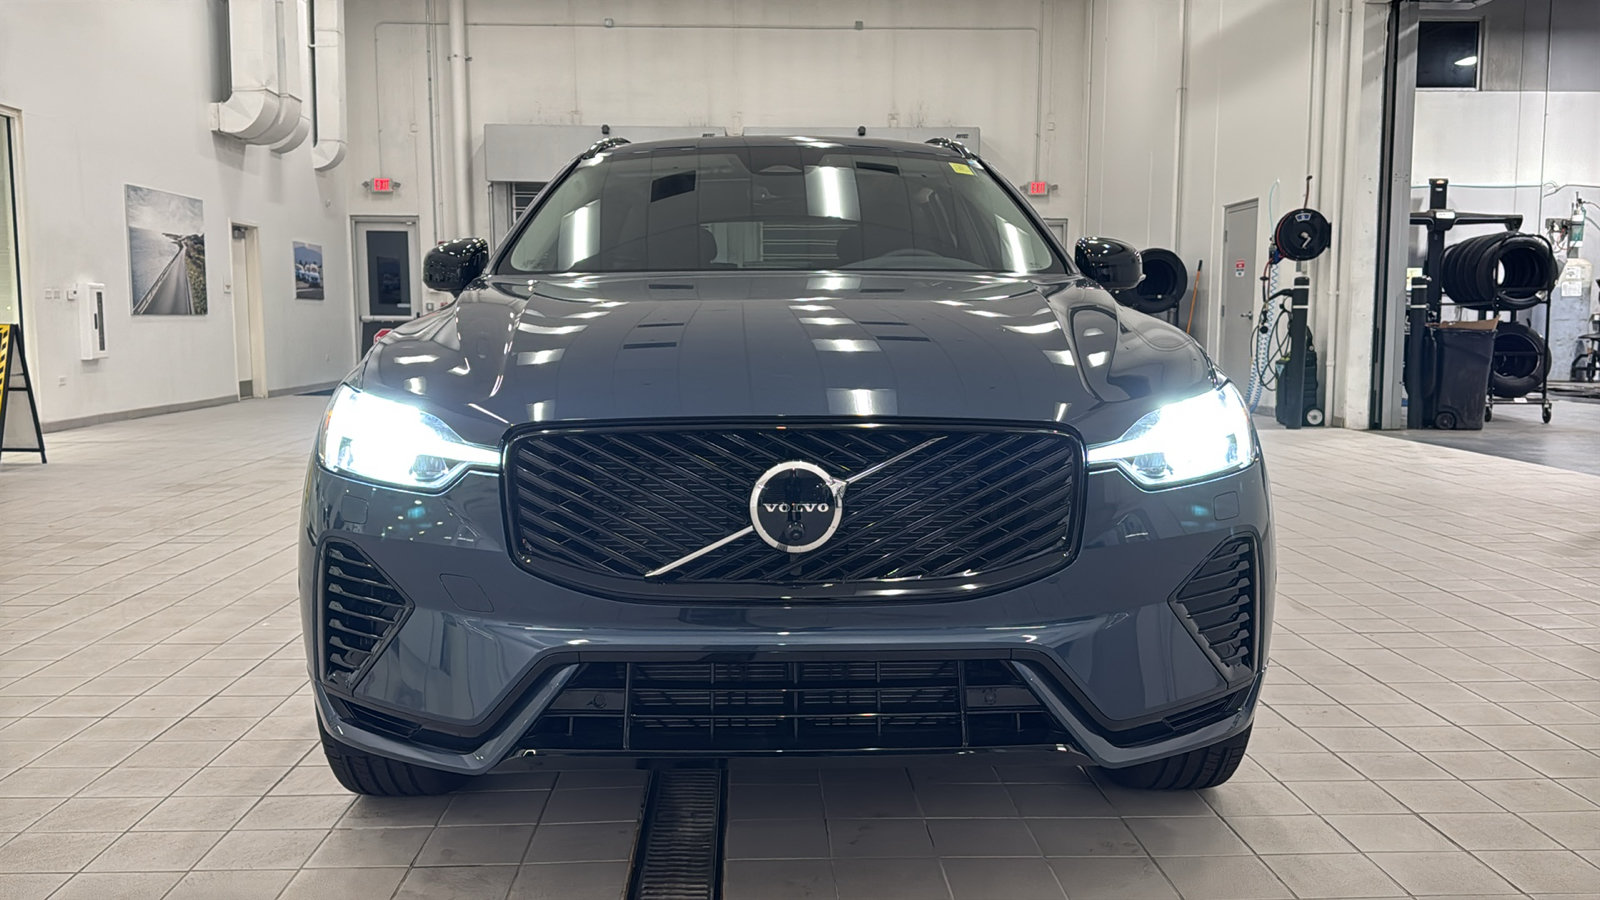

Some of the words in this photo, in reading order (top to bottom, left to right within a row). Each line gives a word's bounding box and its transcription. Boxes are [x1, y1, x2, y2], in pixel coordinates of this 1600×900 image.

[375, 179, 390, 190] EXIT
[1031, 182, 1045, 193] EXIT
[763, 503, 829, 513] VOLVO
